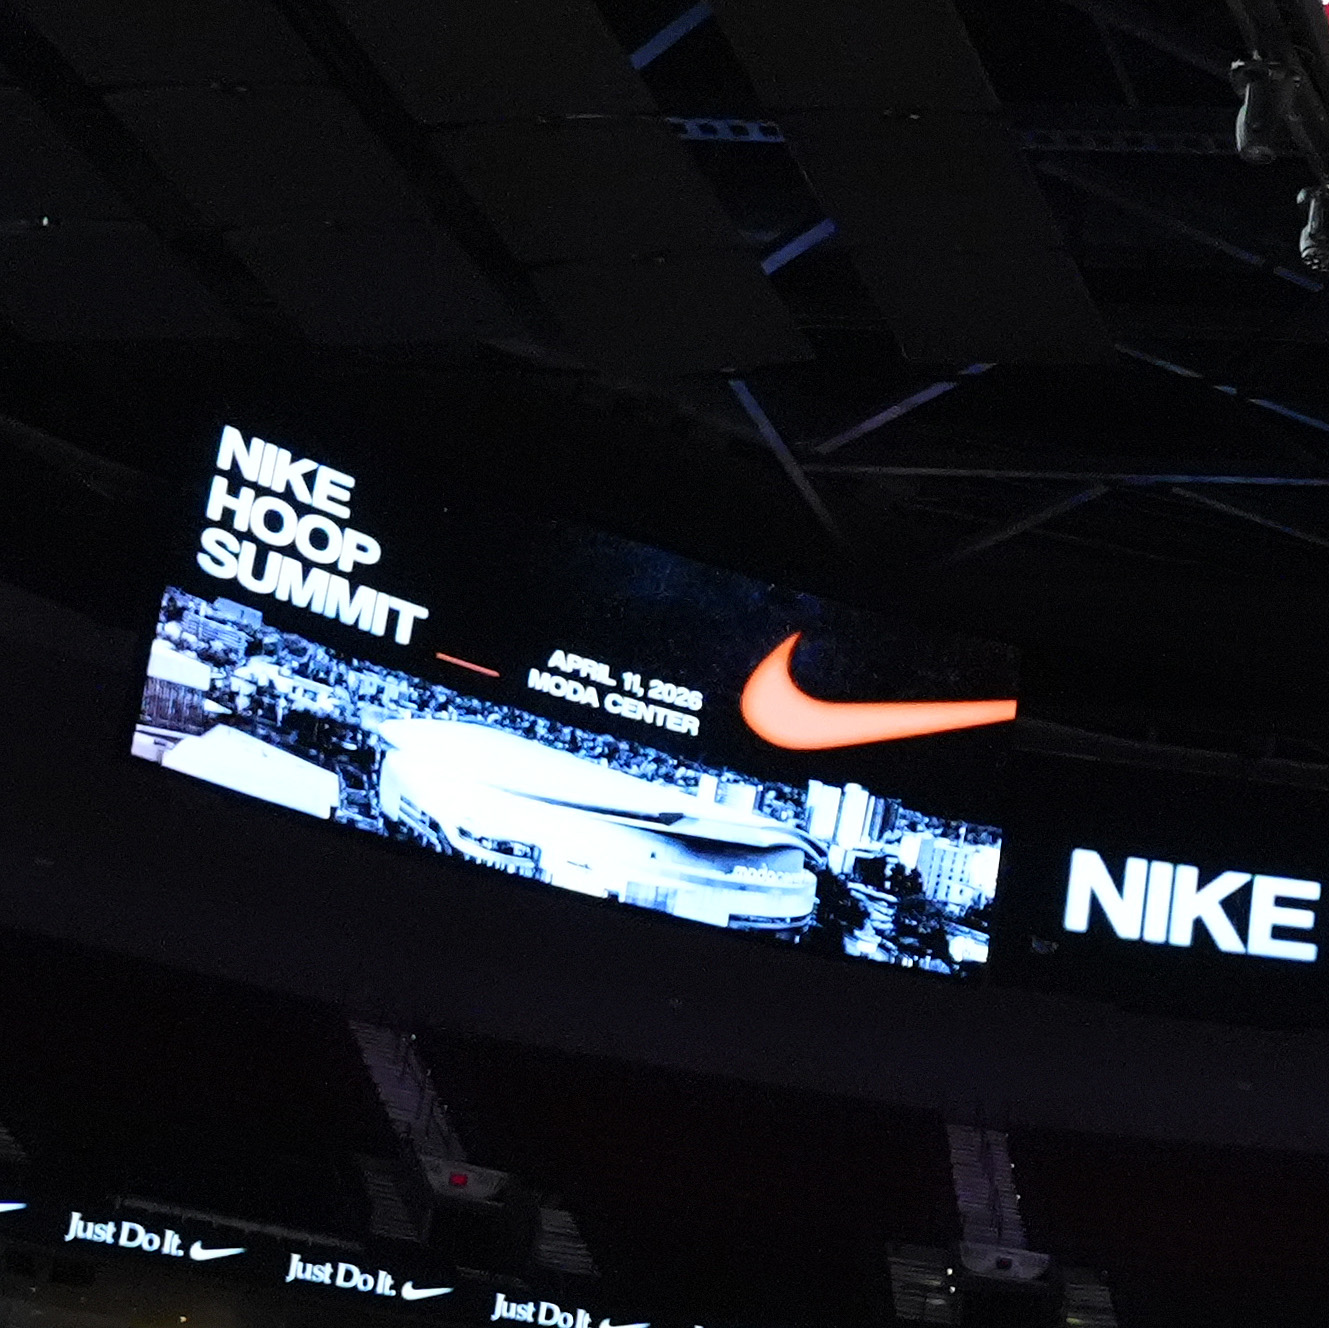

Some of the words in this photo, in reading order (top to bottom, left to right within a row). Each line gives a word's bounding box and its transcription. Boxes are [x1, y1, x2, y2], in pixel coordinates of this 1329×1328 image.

[217, 426, 355, 519] NIKE
[206, 475, 381, 573] HOOP
[197, 528, 429, 645] SUMMIT
[528, 668, 600, 708] MODA
[603, 692, 700, 737] CENTER
[548, 649, 617, 687] APRIL
[648, 679, 704, 711] 2026
[1063, 848, 1322, 962] NIKE
[64, 1211, 117, 1245] Just
[118, 1220, 161, 1252] Do
[161, 1229, 184, 1257] It.
[285, 1253, 334, 1285] Just
[335, 1262, 375, 1292] Do
[375, 1269, 397, 1297] It.
[490, 1292, 536, 1323] Just
